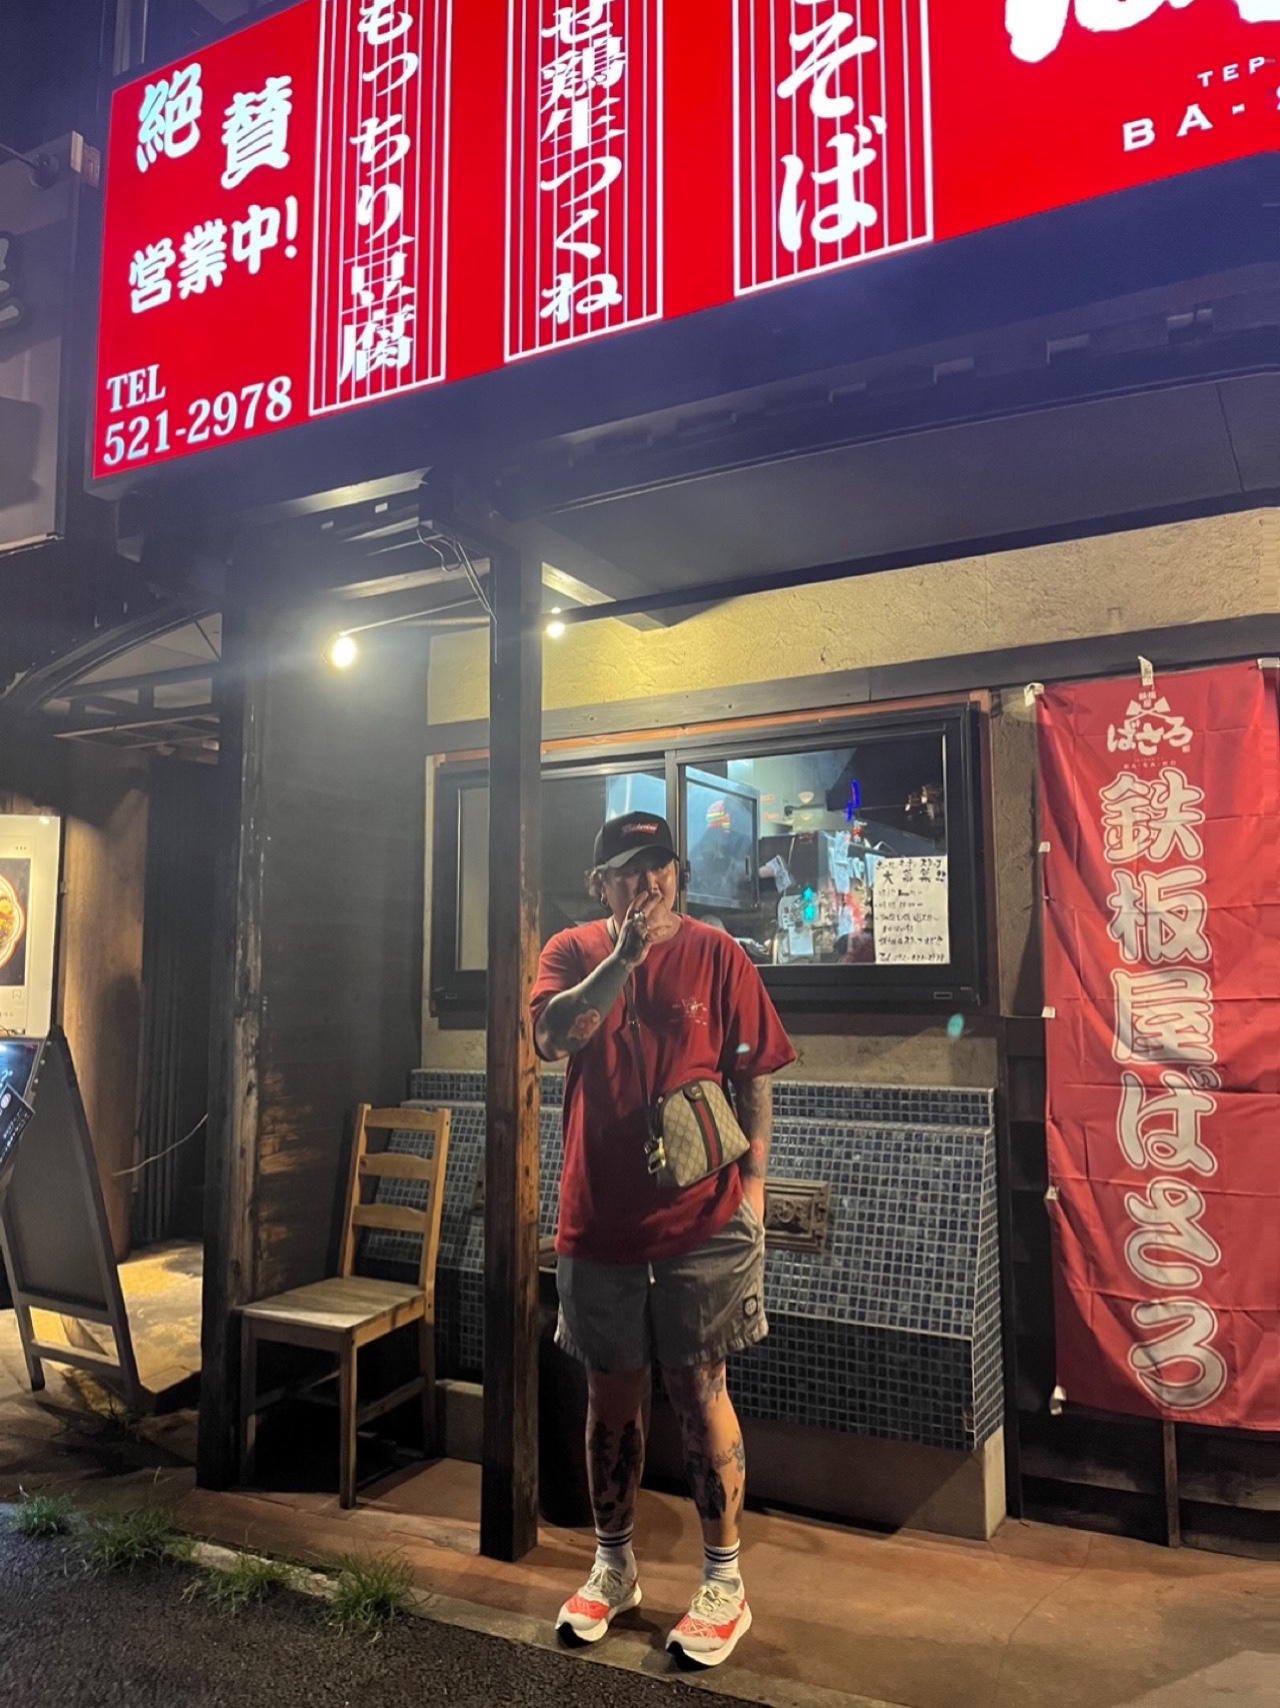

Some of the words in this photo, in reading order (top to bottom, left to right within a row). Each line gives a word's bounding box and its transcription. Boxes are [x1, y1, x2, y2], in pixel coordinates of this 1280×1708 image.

[136, 62, 293, 189] 絶賛
[777, 0, 887, 252] そば
[1122, 86, 1280, 152] BA-
[103, 375, 292, 466] 521-2978
[106, 363, 166, 413] TEL
[1107, 716, 1193, 756] ばさろ
[1100, 767, 1227, 1410] 鉄板屋ばさろ
